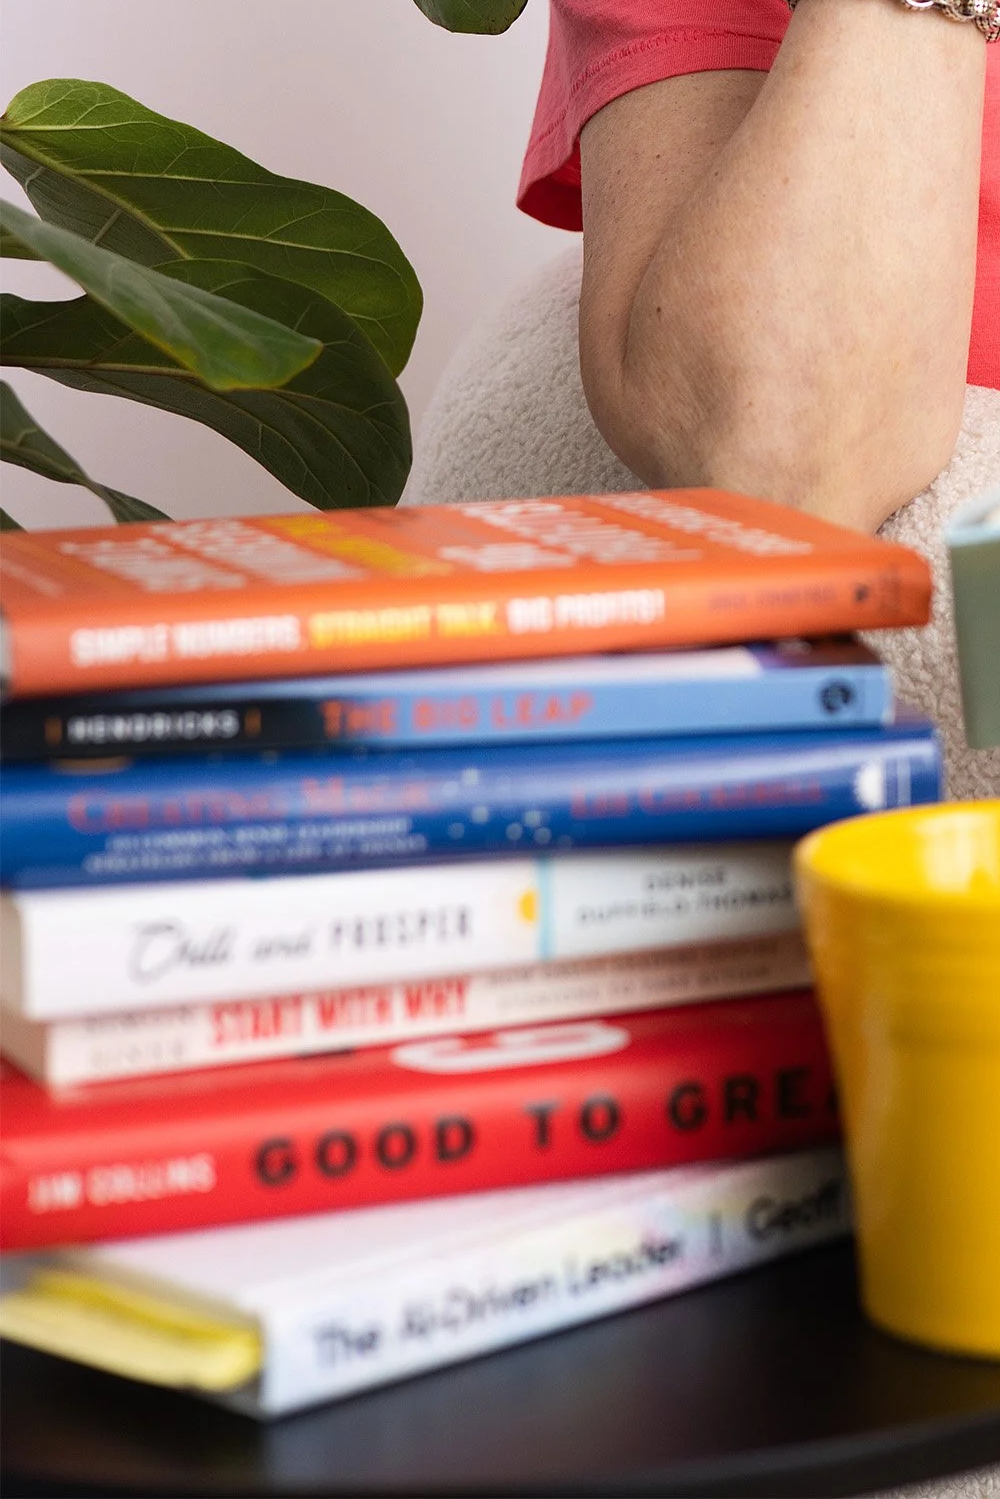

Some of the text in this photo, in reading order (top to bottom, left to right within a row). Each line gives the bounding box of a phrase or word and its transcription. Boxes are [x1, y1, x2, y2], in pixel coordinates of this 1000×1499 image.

[506, 597, 552, 634] BIG
[68, 709, 239, 743] HENDRICKS
[322, 689, 596, 739] THE BIG LEAP
[252, 1065, 844, 1189] GOOD TO GRE
[86, 1151, 216, 1207] COLLINS
